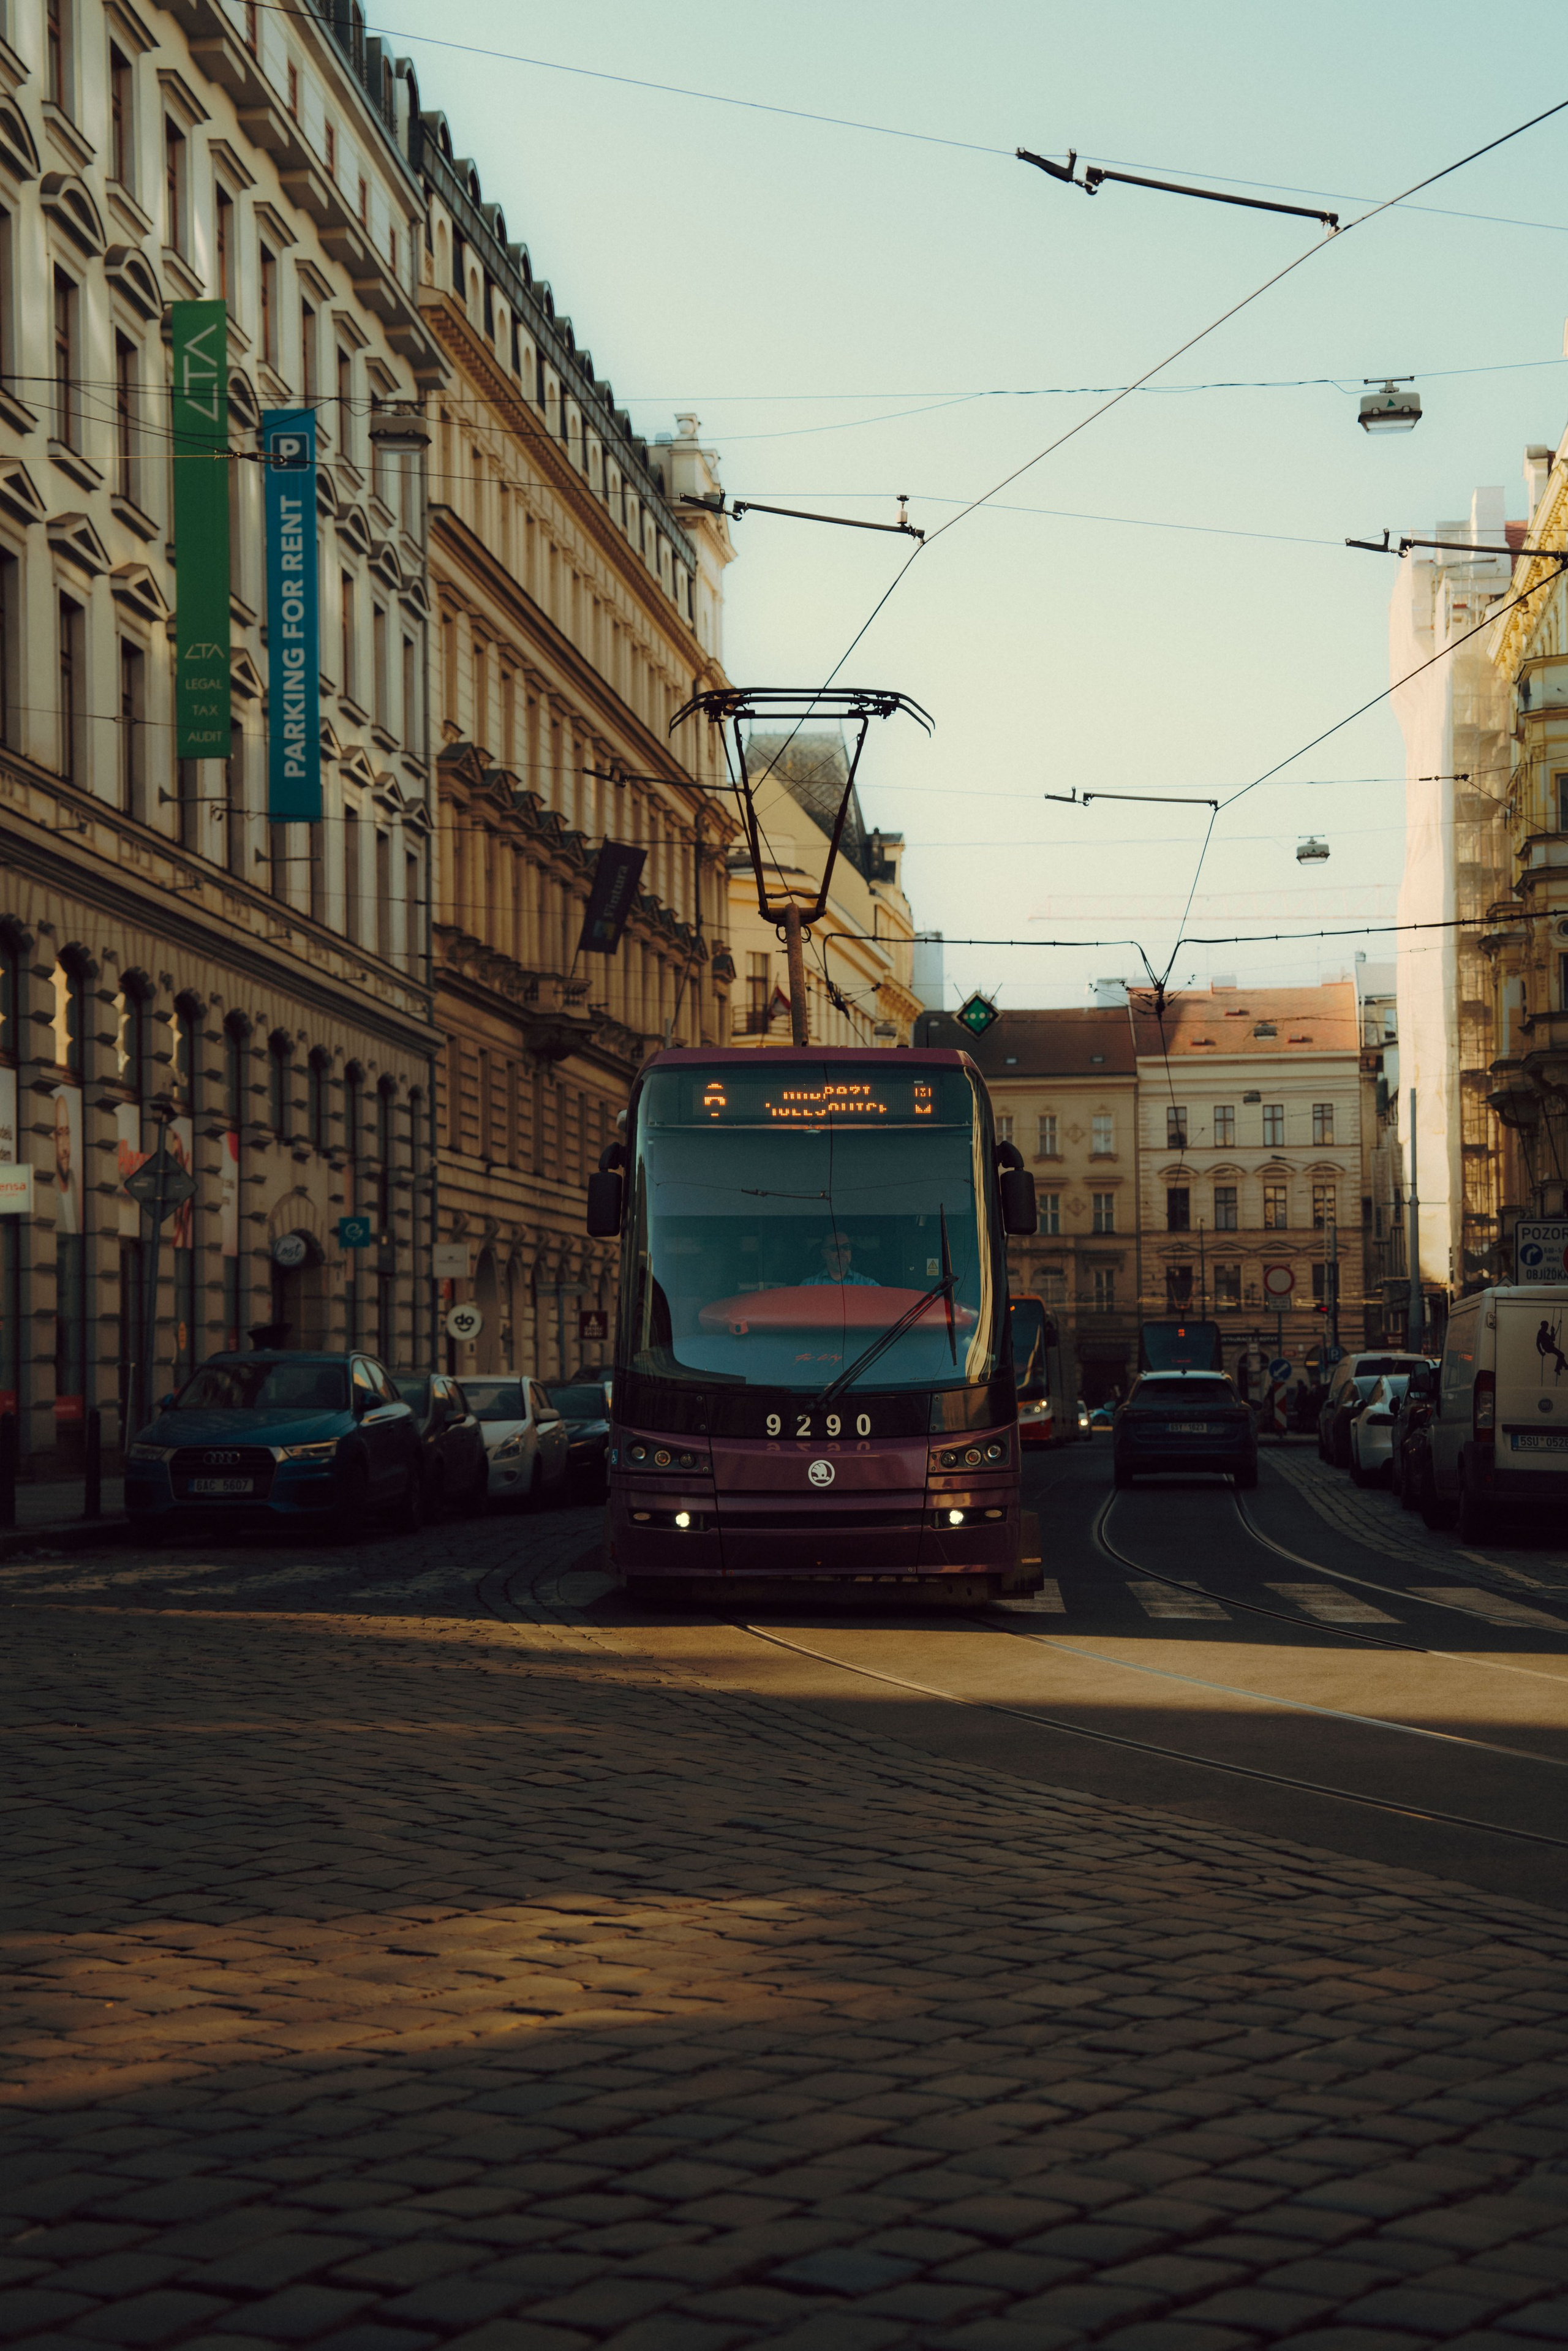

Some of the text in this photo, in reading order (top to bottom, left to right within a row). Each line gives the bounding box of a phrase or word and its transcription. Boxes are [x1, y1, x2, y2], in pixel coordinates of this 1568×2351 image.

[279, 438, 301, 466] P
[280, 494, 306, 778] PARKING FOR RENT
[186, 678, 224, 690] LEGAL
[192, 704, 219, 716] TAX
[187, 731, 222, 742] AUDIT
[454, 1313, 474, 1326] do
[766, 1414, 871, 1436] 9290
[1520, 1436, 1539, 1446] 5SU
[196, 1479, 248, 1491] 6AC 5607
